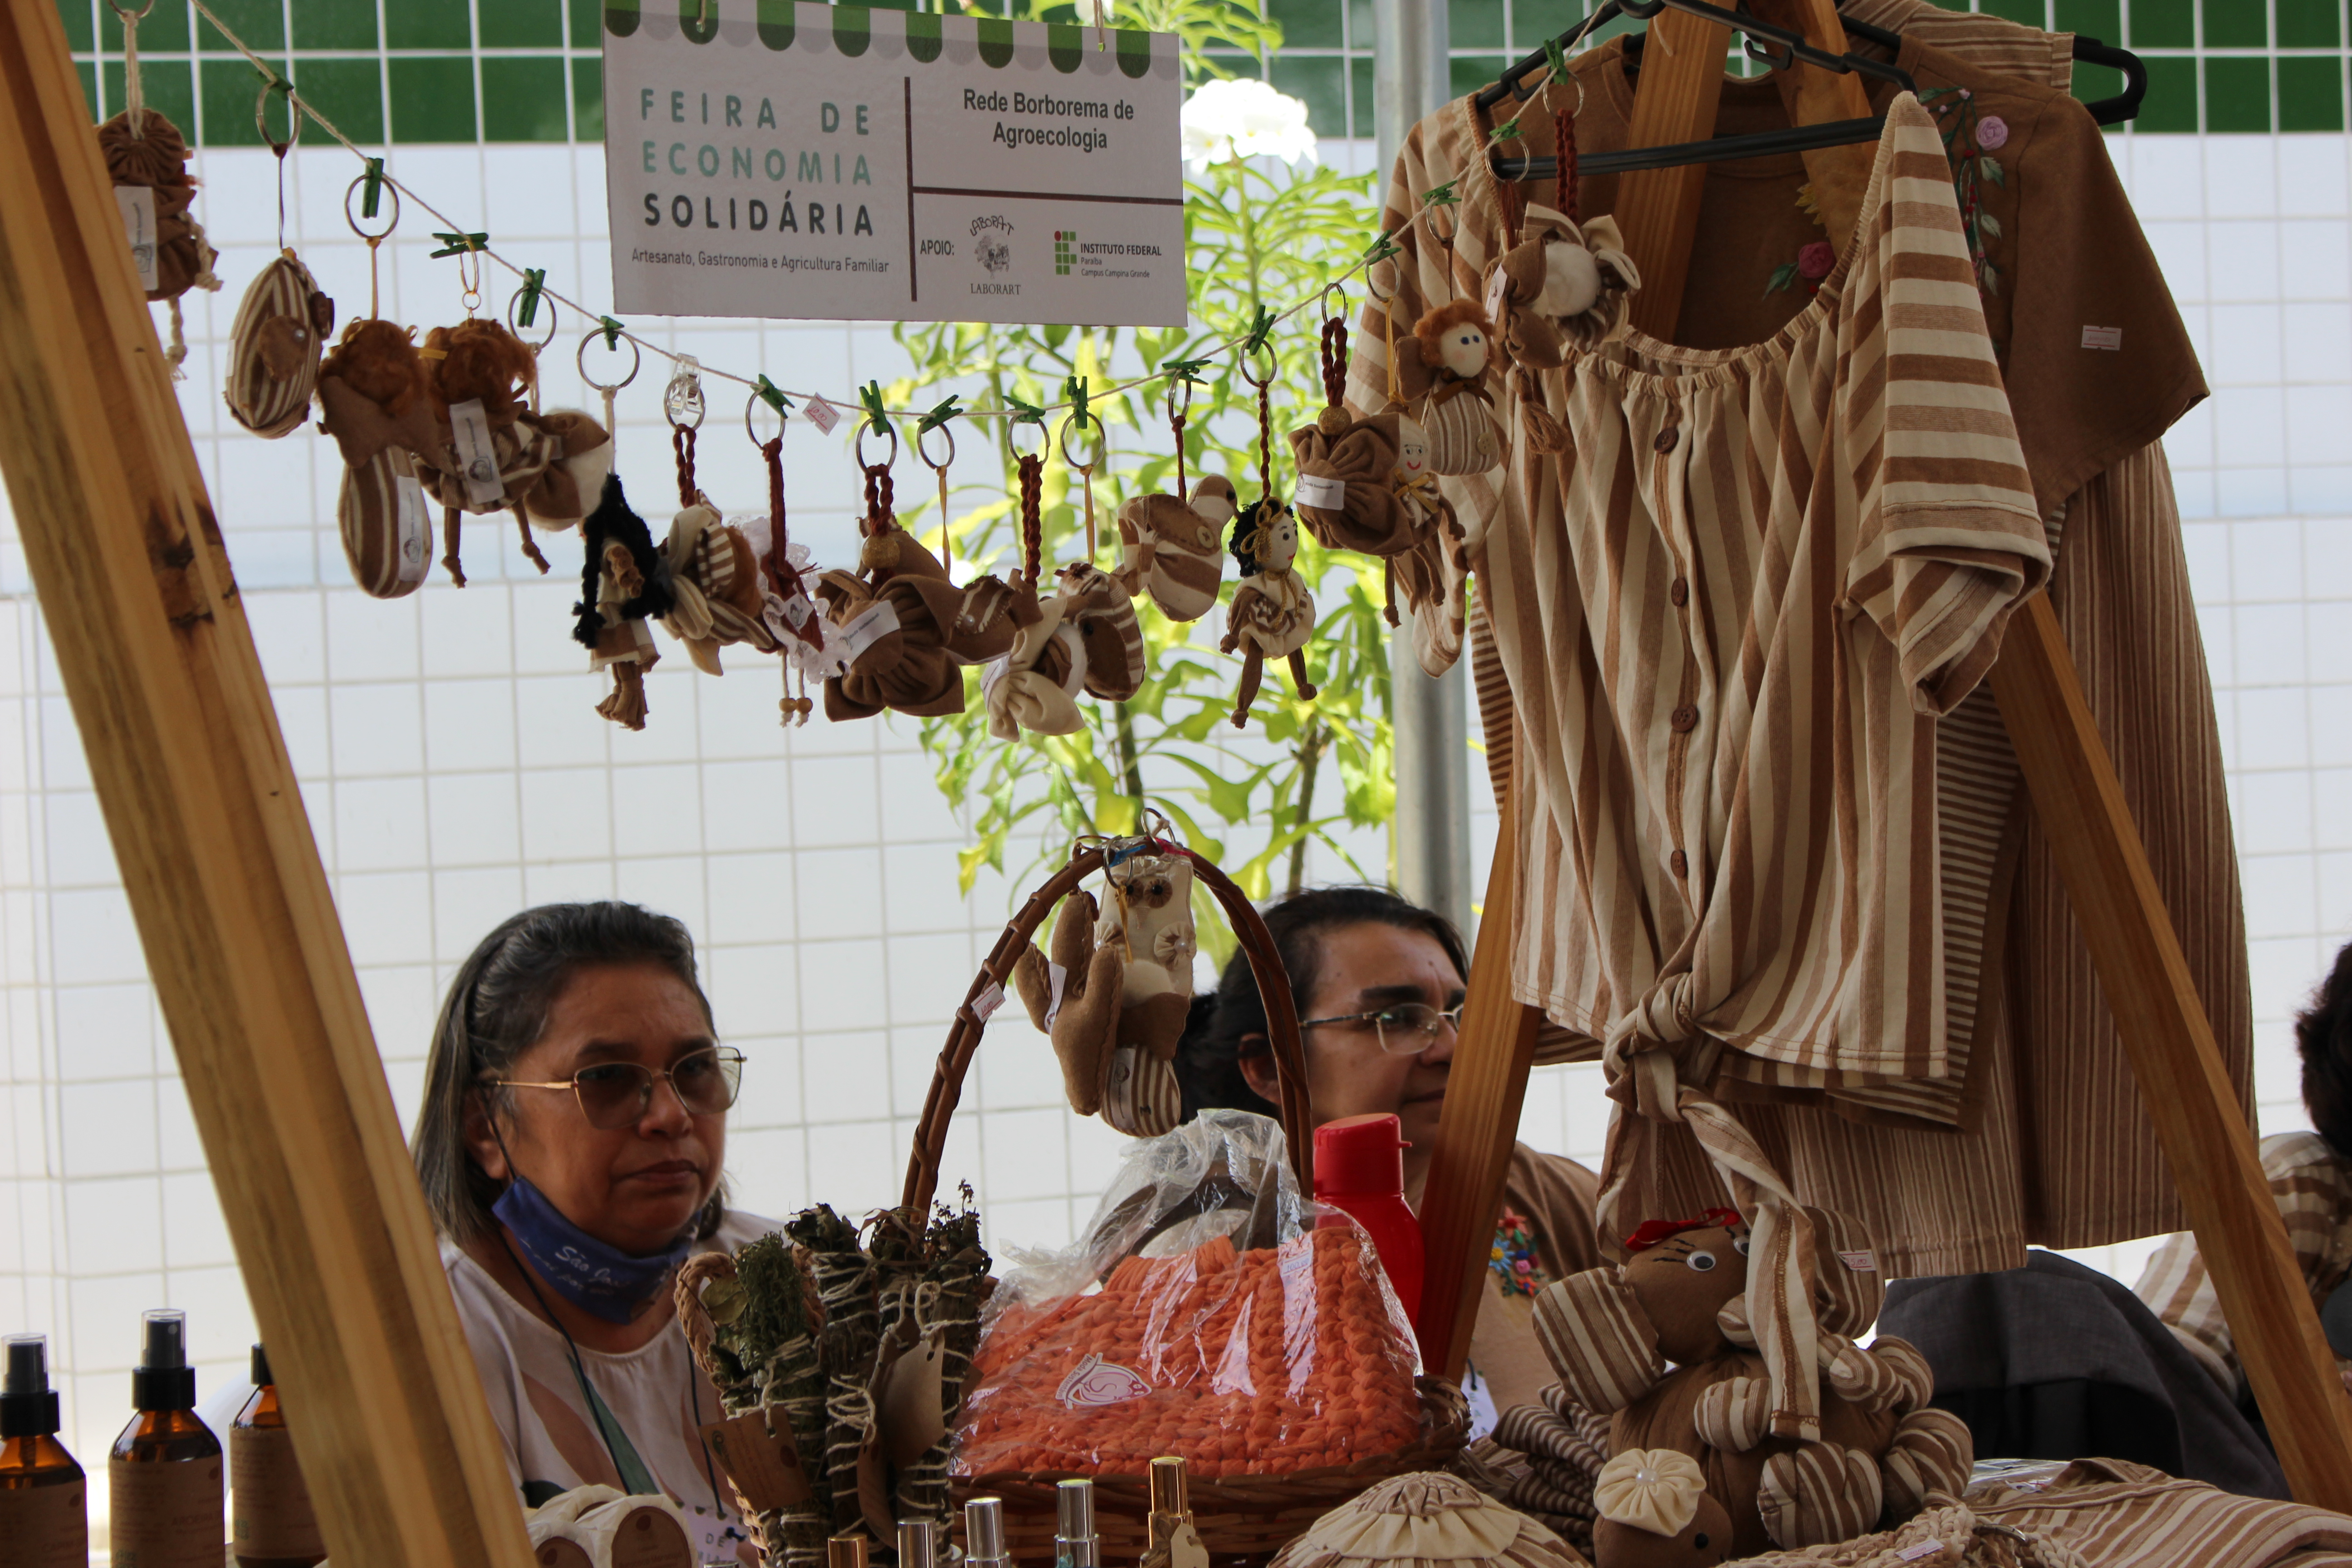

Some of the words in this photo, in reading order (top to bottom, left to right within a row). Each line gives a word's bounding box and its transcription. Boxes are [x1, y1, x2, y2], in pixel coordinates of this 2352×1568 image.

[641, 88, 776, 129] FEIRA
[821, 102, 869, 135] DE
[963, 88, 1008, 112] Rede
[1014, 92, 1108, 119] Borborema
[1113, 99, 1134, 120] de
[992, 121, 1107, 153] Agroecologia
[642, 140, 872, 186] ECONOMIA
[643, 189, 873, 236] SOLIDÁRIA
[920, 239, 955, 256] APOIO:
[1080, 243, 1124, 255] INSTITUTO
[1126, 245, 1162, 256] FEDERAL
[632, 248, 695, 267] Artesanato,
[698, 251, 769, 269] Gastronomia
[771, 258, 778, 269] e
[780, 255, 842, 273] Agricultura
[844, 257, 889, 273] Familiar
[1081, 256, 1102, 265] Paraíba
[1081, 268, 1104, 278] Campus
[1105, 269, 1129, 279] Campina
[1130, 270, 1150, 278] Grande
[970, 283, 1021, 295] LABORART
[1077, 1355, 1092, 1371] Moda
